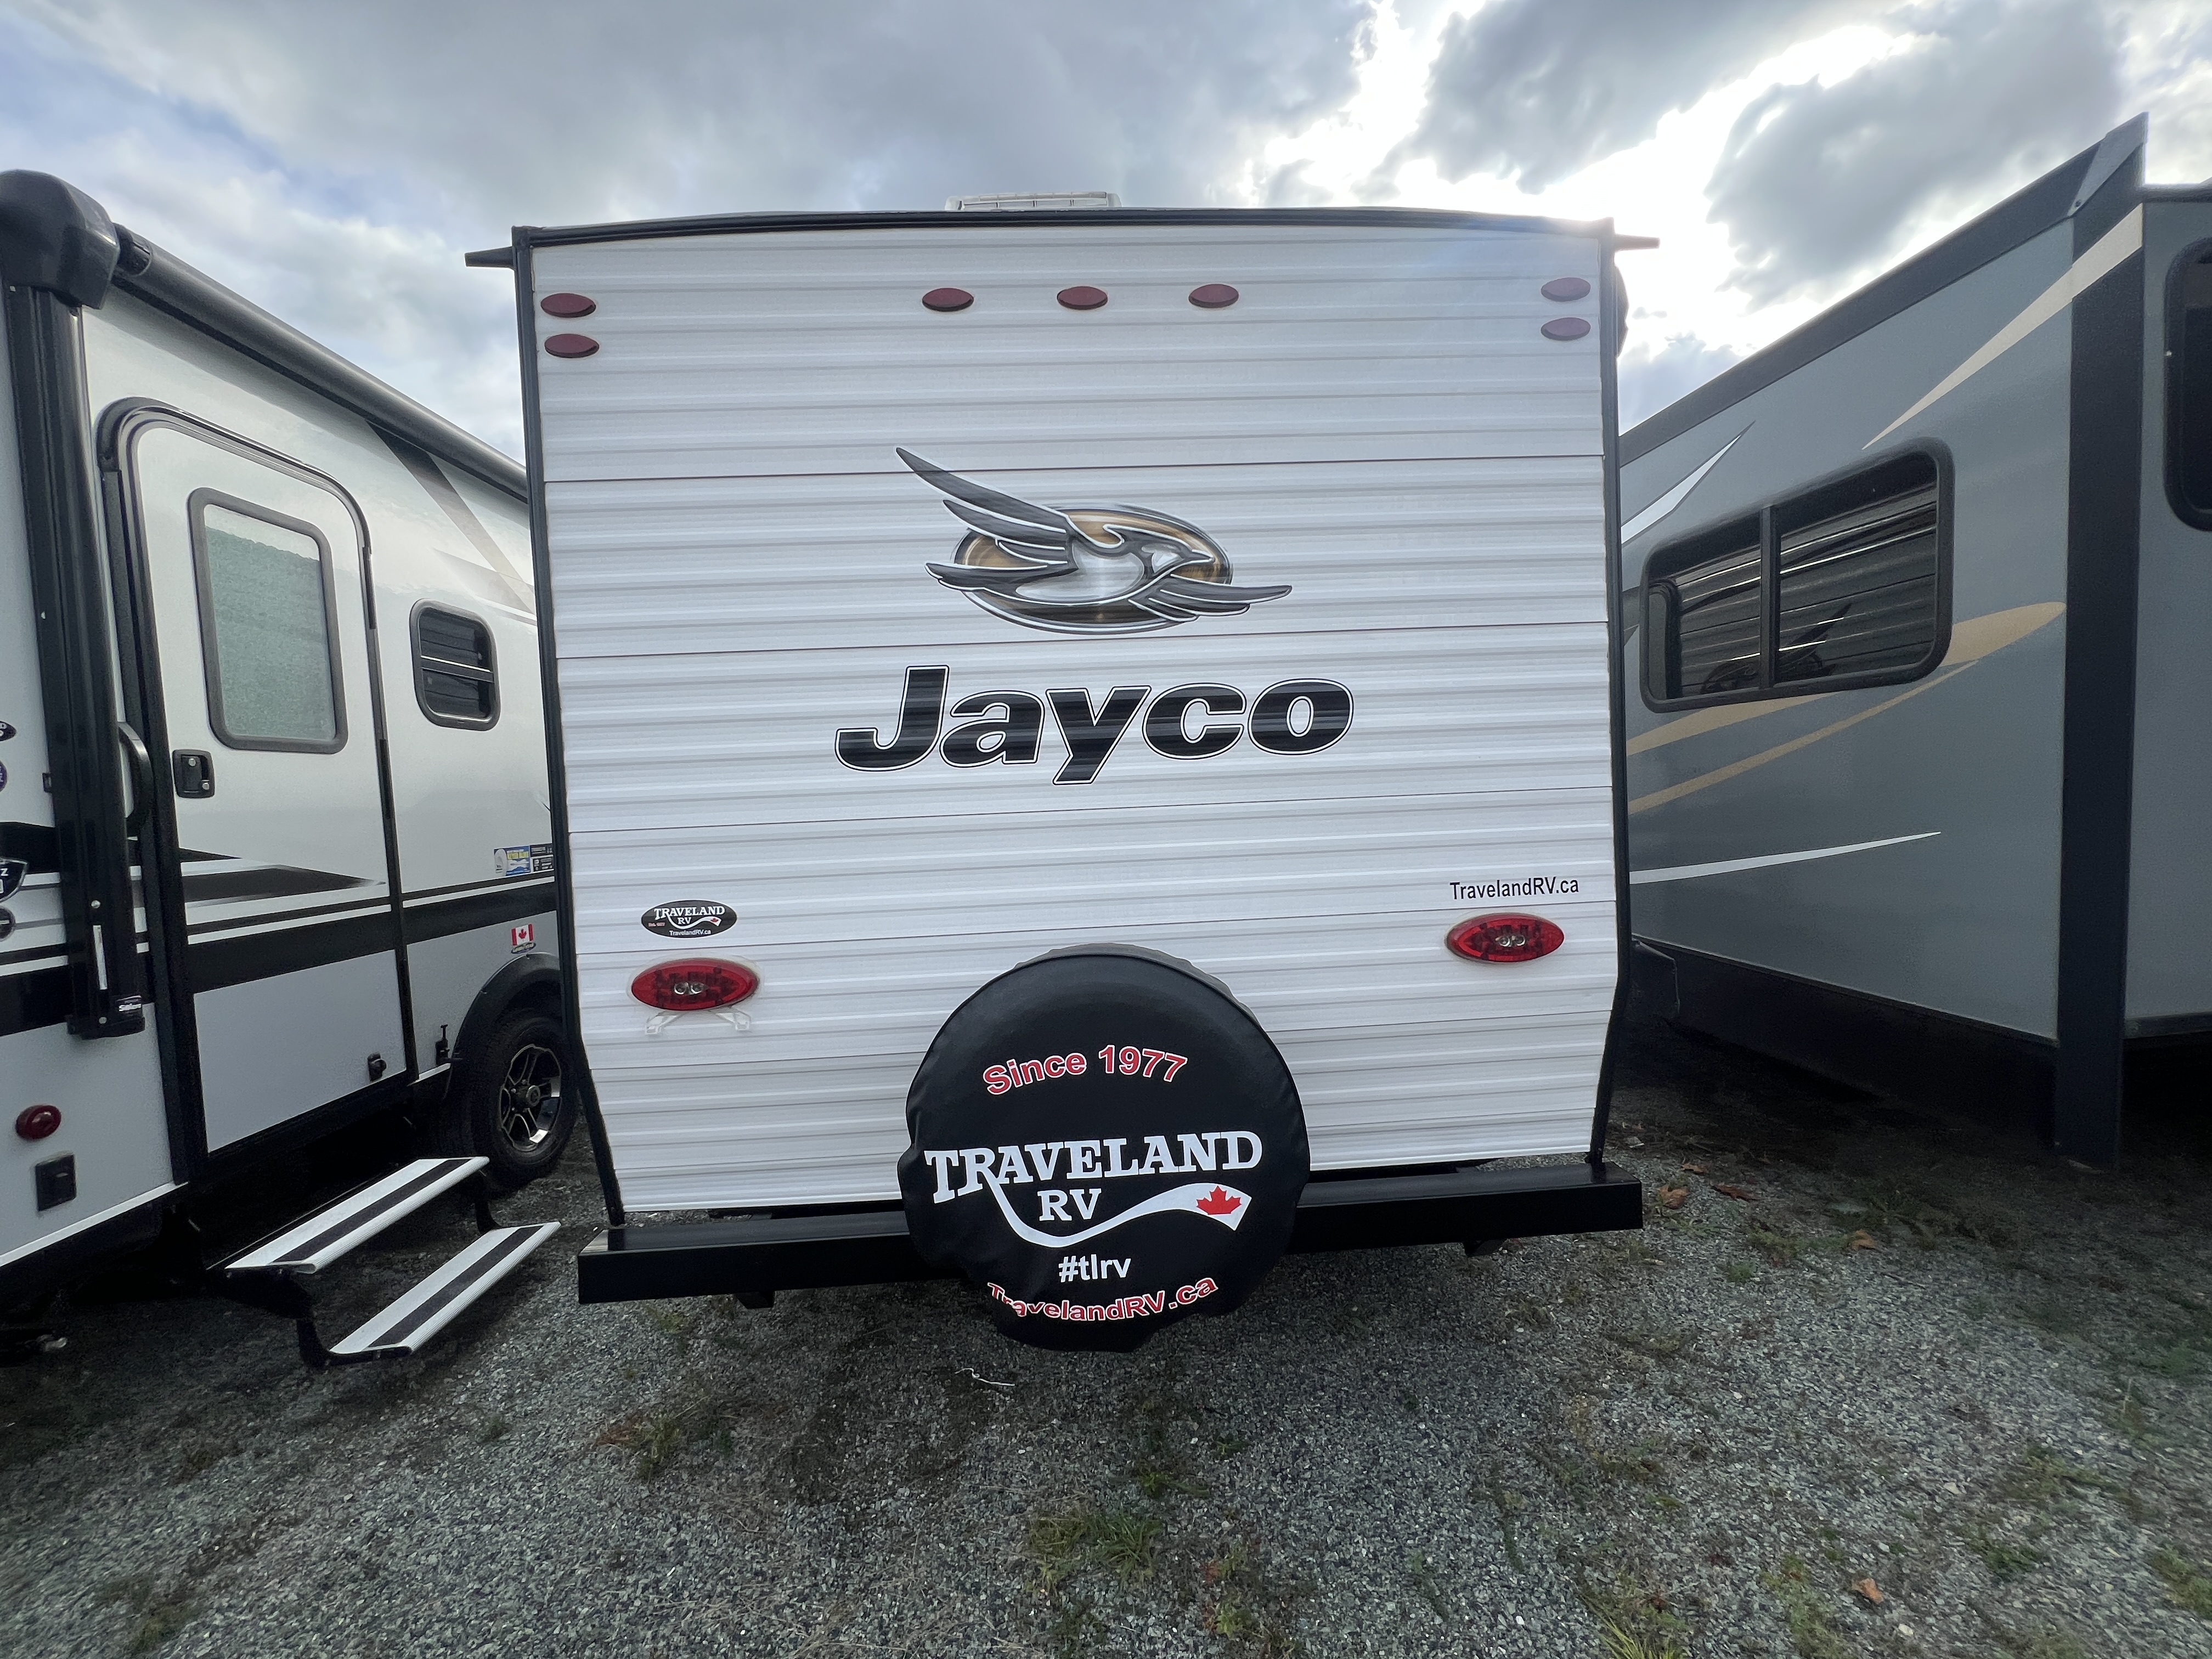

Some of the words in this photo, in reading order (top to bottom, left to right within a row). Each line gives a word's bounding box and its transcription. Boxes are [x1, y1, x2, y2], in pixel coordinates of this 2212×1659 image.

[835, 665, 1353, 785] Jayco
[1449, 876, 1579, 900] TravelandRV.ca
[654, 906, 725, 920] TRAVELAND
[983, 1051, 1087, 1095] Since
[1098, 1045, 1188, 1083] 1977
[924, 1130, 1263, 1204] TRAVELAND
[1037, 1188, 1102, 1222] RV
[1058, 1254, 1131, 1283] #tlrv
